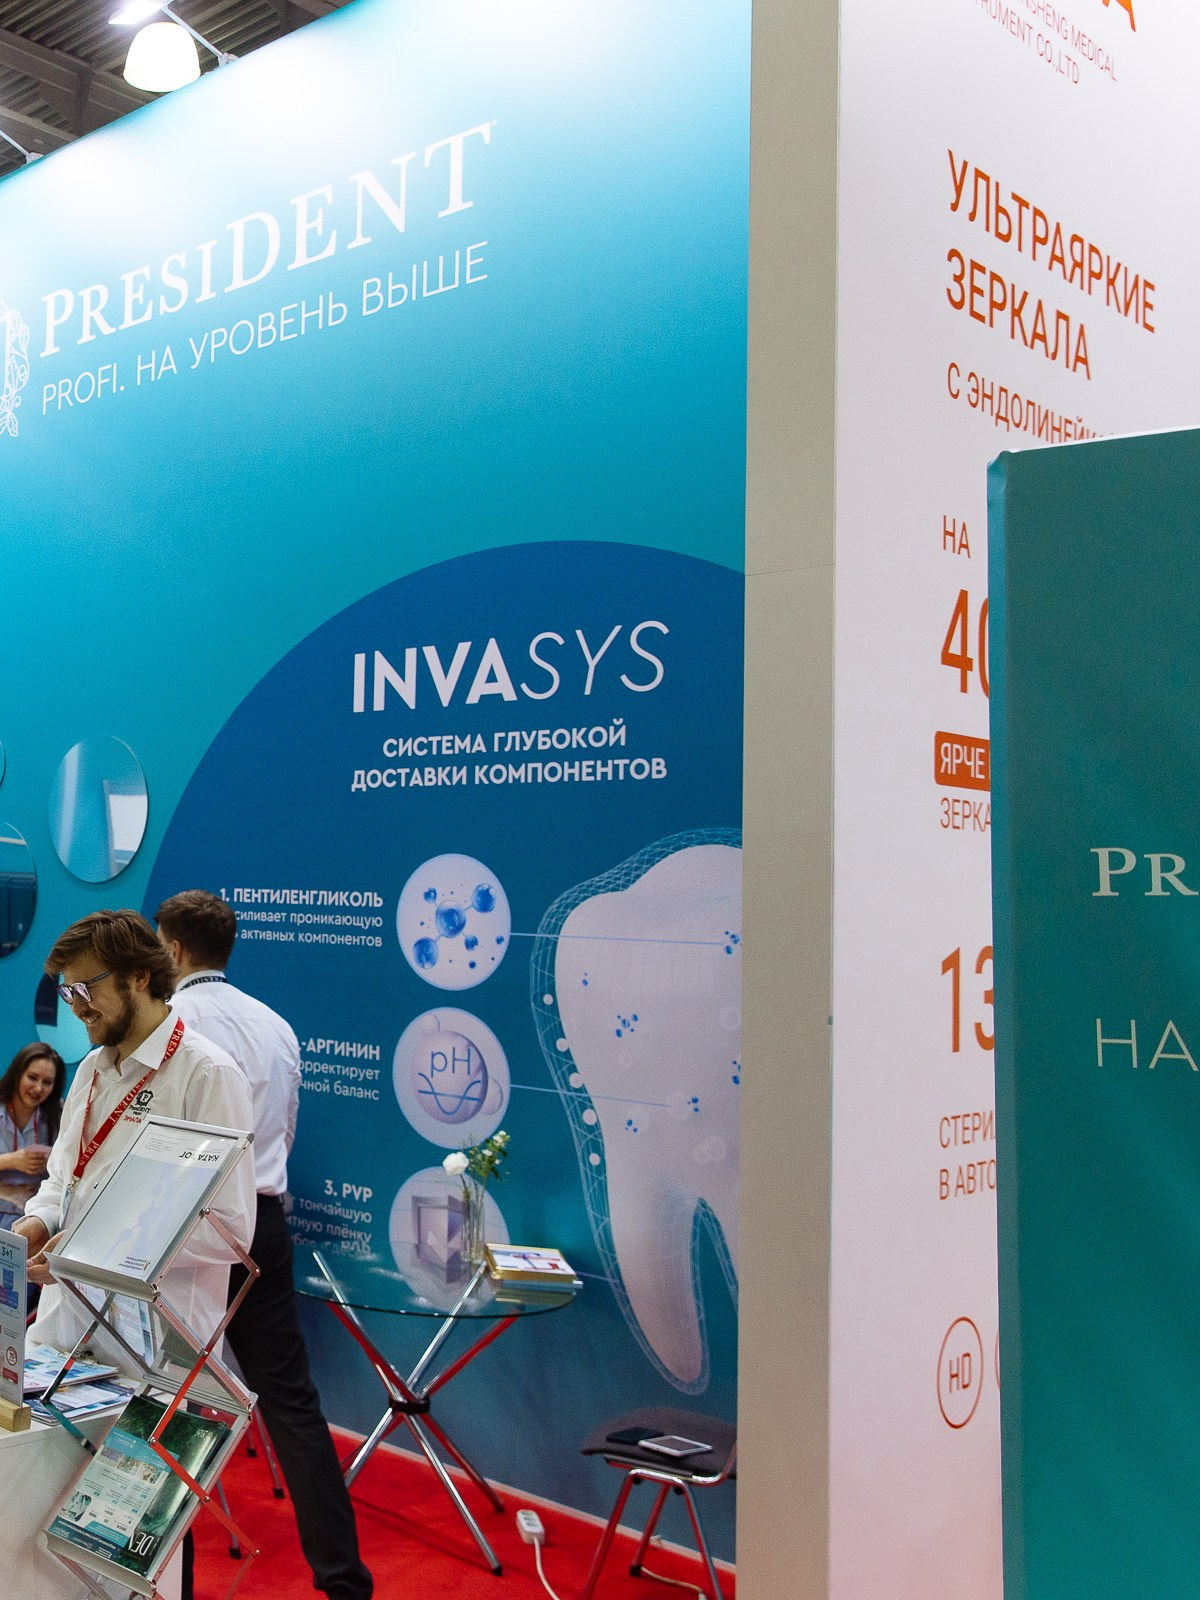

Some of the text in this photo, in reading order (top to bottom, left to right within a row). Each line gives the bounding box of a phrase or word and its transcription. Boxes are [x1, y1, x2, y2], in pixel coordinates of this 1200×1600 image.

[1017, 0, 1068, 40] SHENG
[1071, 25, 1117, 82] MEDICAL
[39, 119, 494, 359] PRESIDENT
[947, 149, 1156, 334] УЛЬТРАЯРКИЕ
[42, 240, 489, 416] PROFI. НА УРОВЕНЬ ВЫШЕ
[946, 248, 1091, 381] ЗЕРКАЛА
[947, 362, 1114, 444] С ЭНДОЛИНЕЙ
[942, 514, 971, 559] НА
[352, 620, 670, 713] INVASYS
[382, 718, 627, 758] СИСТЕМА ГЛУБОКОЙ
[351, 757, 668, 792] ДОСТАВКИ КОМПОНЕНТОВ
[940, 742, 986, 779] ЯРЧЕ
[940, 797, 991, 832] ЗЕРКА
[233, 888, 383, 908] ПЕНТИЛЕНГЛИКОЛЬ
[234, 910, 383, 928] силивает проникающую
[240, 929, 295, 943] активных
[297, 933, 383, 948] компонентов
[299, 1038, 380, 1061] -АРГИНИН
[430, 1046, 472, 1078] pH
[1096, 1018, 1199, 1072] НА
[299, 1060, 380, 1081] орректирует
[300, 1078, 380, 1100] чной баланс
[939, 1110, 995, 1149] СТЕРИ
[324, 1179, 373, 1203] 3. PVP
[939, 1159, 996, 1200] В АВТО
[299, 1198, 373, 1224] тончайшую
[1, 1246, 13, 1259] 3+1
[948, 1352, 973, 1394] HD
